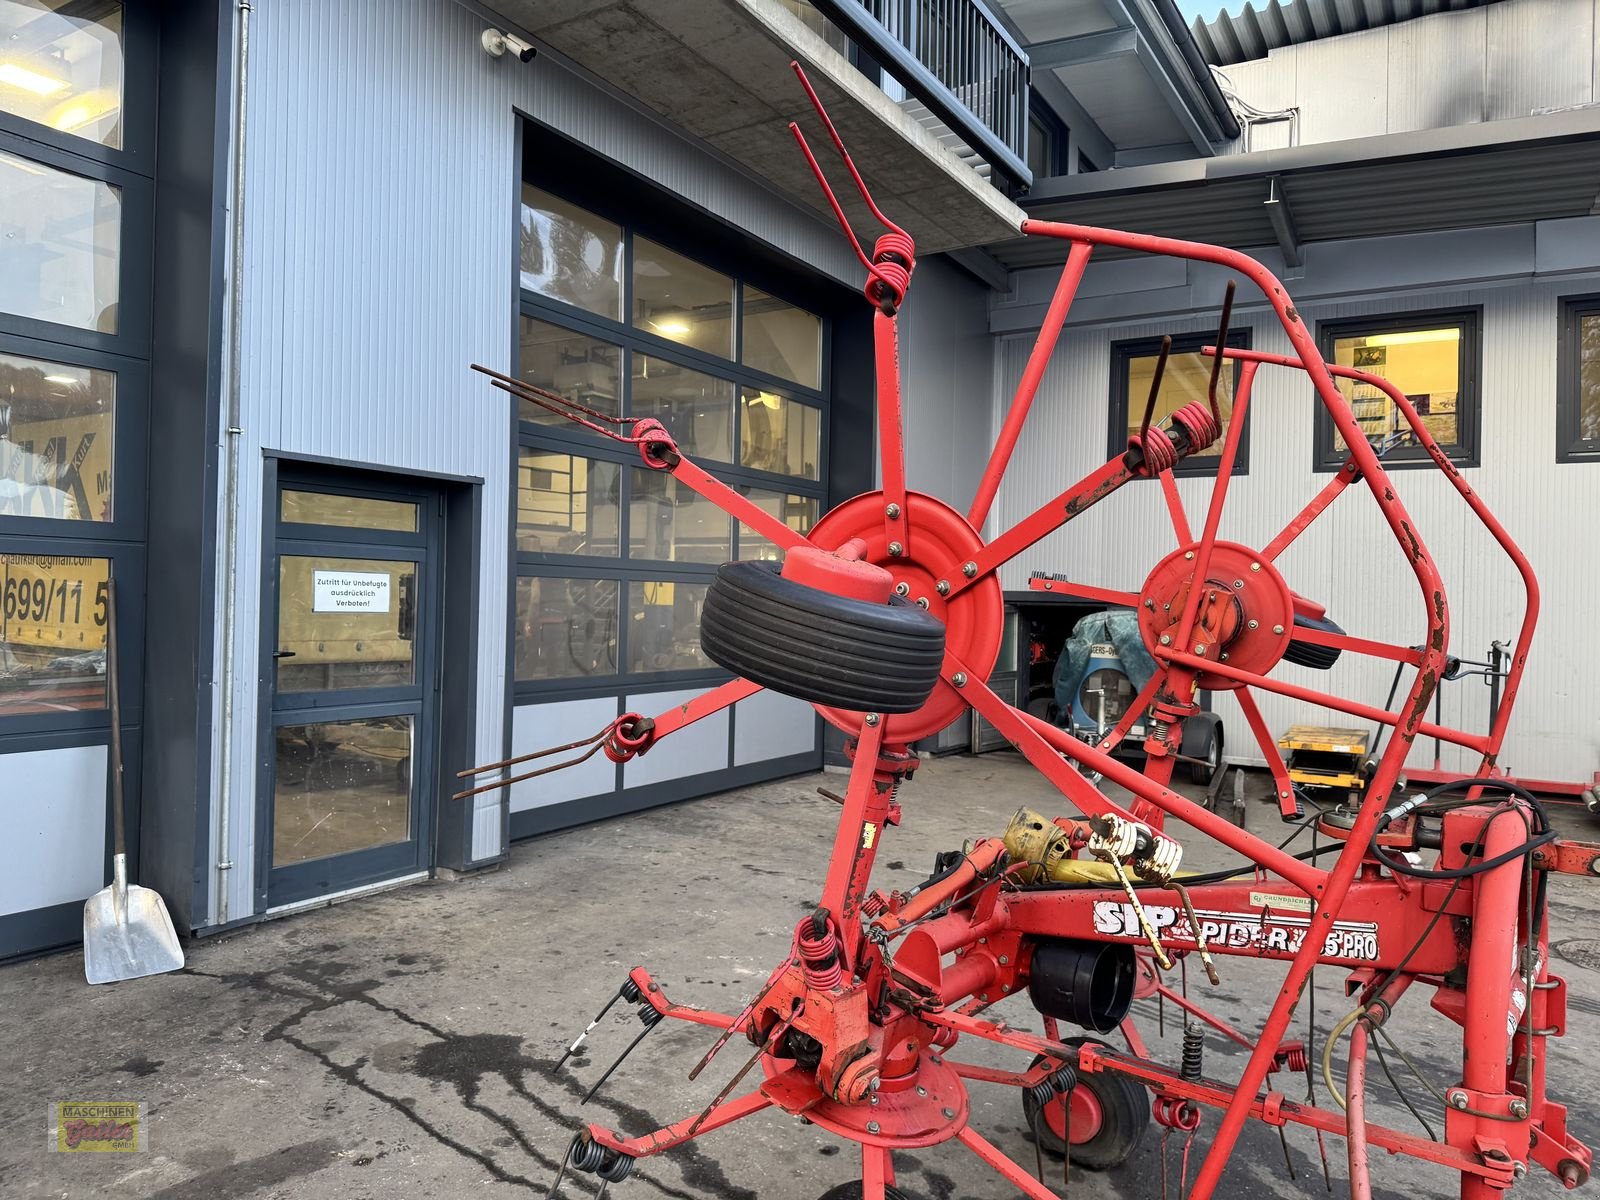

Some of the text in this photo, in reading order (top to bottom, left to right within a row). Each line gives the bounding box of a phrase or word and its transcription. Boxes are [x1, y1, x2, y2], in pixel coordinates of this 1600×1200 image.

[317, 578, 387, 588] Zutritt für Unbefugte
[1342, 933, 1378, 960] PRO
